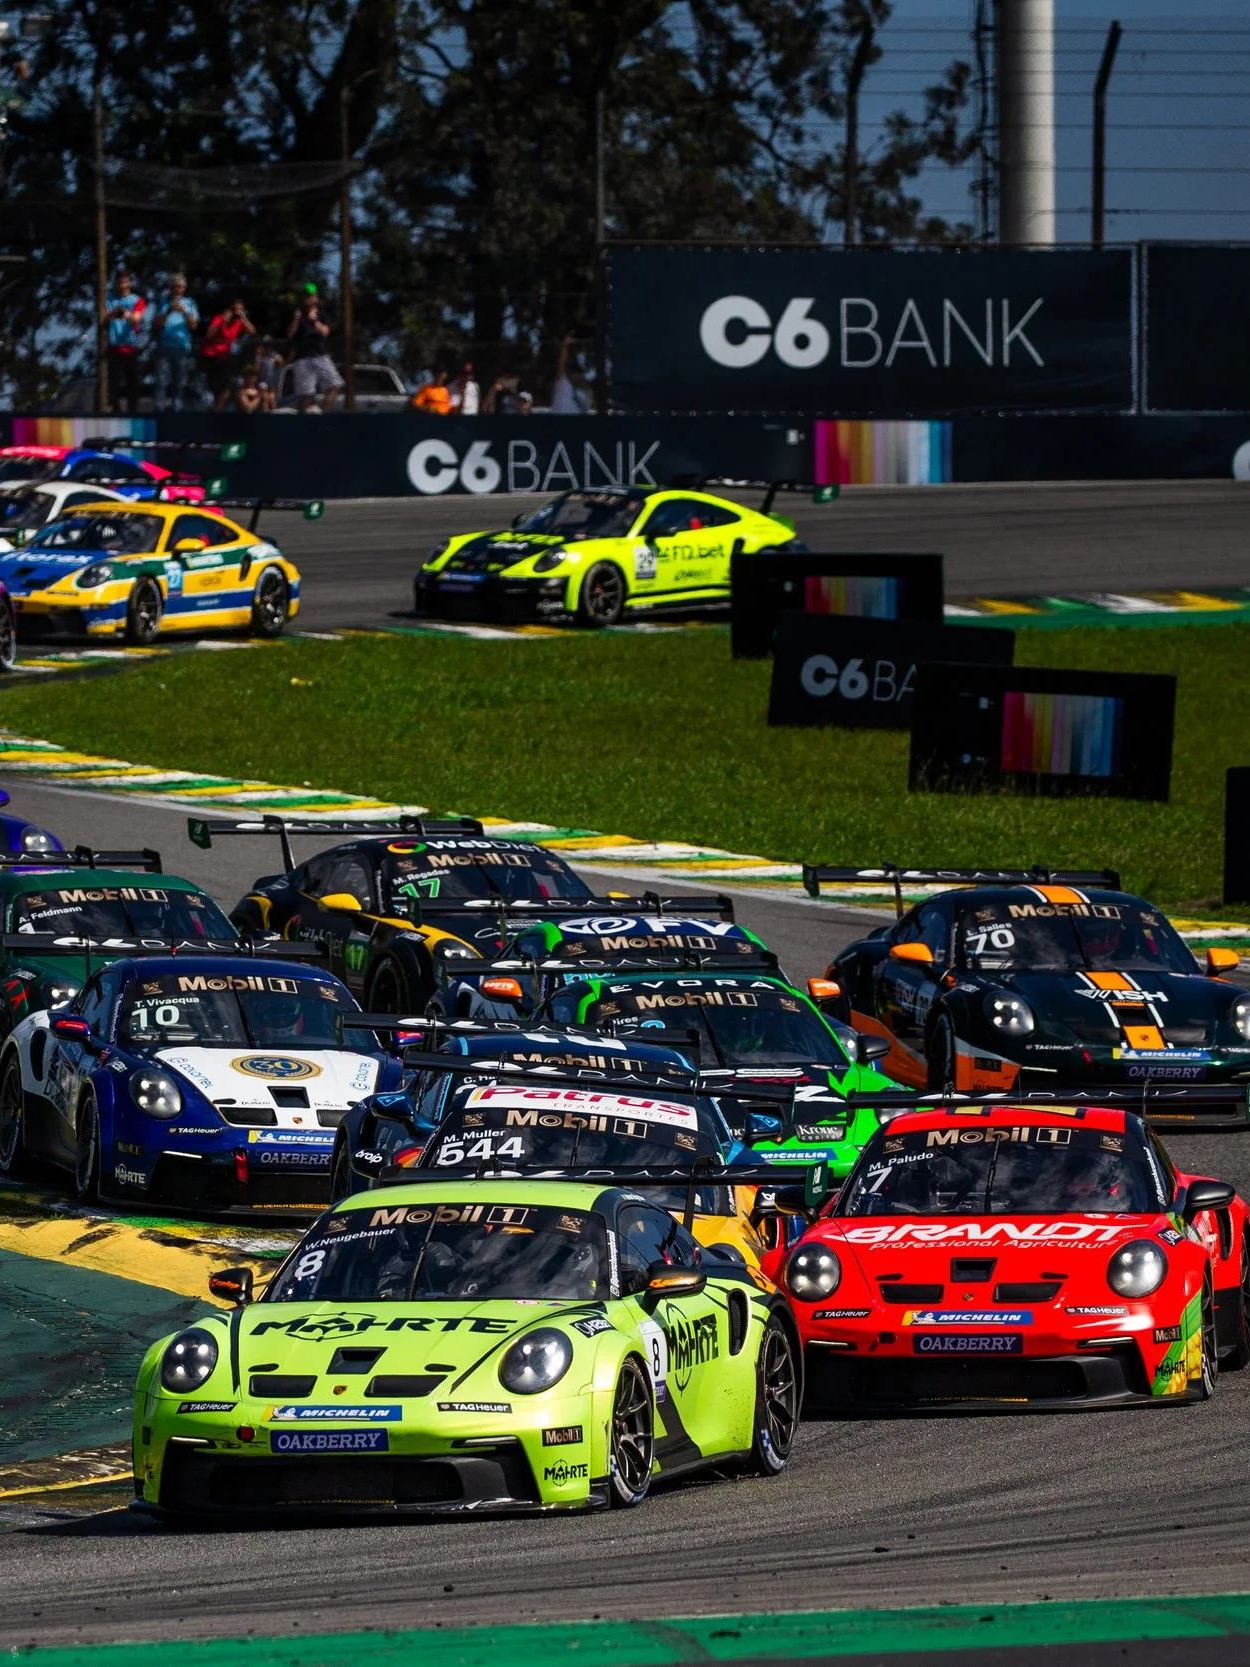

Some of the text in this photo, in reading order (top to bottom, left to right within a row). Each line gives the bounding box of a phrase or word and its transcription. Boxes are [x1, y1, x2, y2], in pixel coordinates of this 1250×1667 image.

[699, 295, 1045, 368] C6 BANK
[406, 438, 661, 495] C6 BANK
[799, 653, 870, 699] C6
[425, 839, 547, 854] WebDiet
[427, 852, 503, 867] Mobil
[406, 868, 451, 880] Regadas
[58, 888, 138, 903] Mobil
[397, 877, 441, 898] 17
[19, 905, 83, 924] A. Feldmann
[1008, 902, 1090, 919] Mobil
[600, 934, 684, 950] Mobil
[965, 929, 1016, 955] 70
[177, 975, 264, 992] Mobil
[610, 978, 775, 994] EVORA
[134, 996, 200, 1009] T. Vivacqua
[635, 991, 725, 1009] Mobil
[131, 1005, 181, 1030] 10
[252, 1059, 301, 1071] 30
[512, 1053, 606, 1070] Mobil
[1128, 1067, 1202, 1079] OAKBERRY
[480, 1087, 692, 1117] Patrus
[505, 1110, 607, 1132] Mobil
[552, 1101, 690, 1126] TRANSPORTES
[177, 1126, 220, 1134] TAGHeuer
[443, 1129, 506, 1144] M. Muller
[798, 1124, 838, 1135] Krone
[926, 1127, 1029, 1147] Mobil
[354, 1149, 384, 1165] braip
[436, 1136, 526, 1167] 544
[868, 1151, 935, 1172] M. Paludo
[866, 1166, 893, 1194] 7
[368, 1205, 482, 1228] Mobil
[305, 1228, 397, 1251] W.Neugebauer
[822, 1221, 1150, 1244] BRANDT
[869, 1238, 1120, 1251] Professional Agriculture
[293, 1249, 327, 1279] 8
[824, 1309, 870, 1318] TAGHeuer
[938, 1311, 1022, 1323] MICHELIN
[1076, 1307, 1127, 1315] TAGHeuer
[248, 1314, 520, 1338] MAHRTE
[918, 1336, 1018, 1351] OAKBERRY
[1155, 1329, 1173, 1343] Mobil
[651, 1336, 661, 1377] 8
[188, 1402, 234, 1411] TAGHeuer
[300, 1408, 391, 1418] MICHELIN
[452, 1402, 510, 1413] TAGHeuer
[277, 1433, 381, 1450] OAKBERRY
[545, 1430, 572, 1444] Mobil
